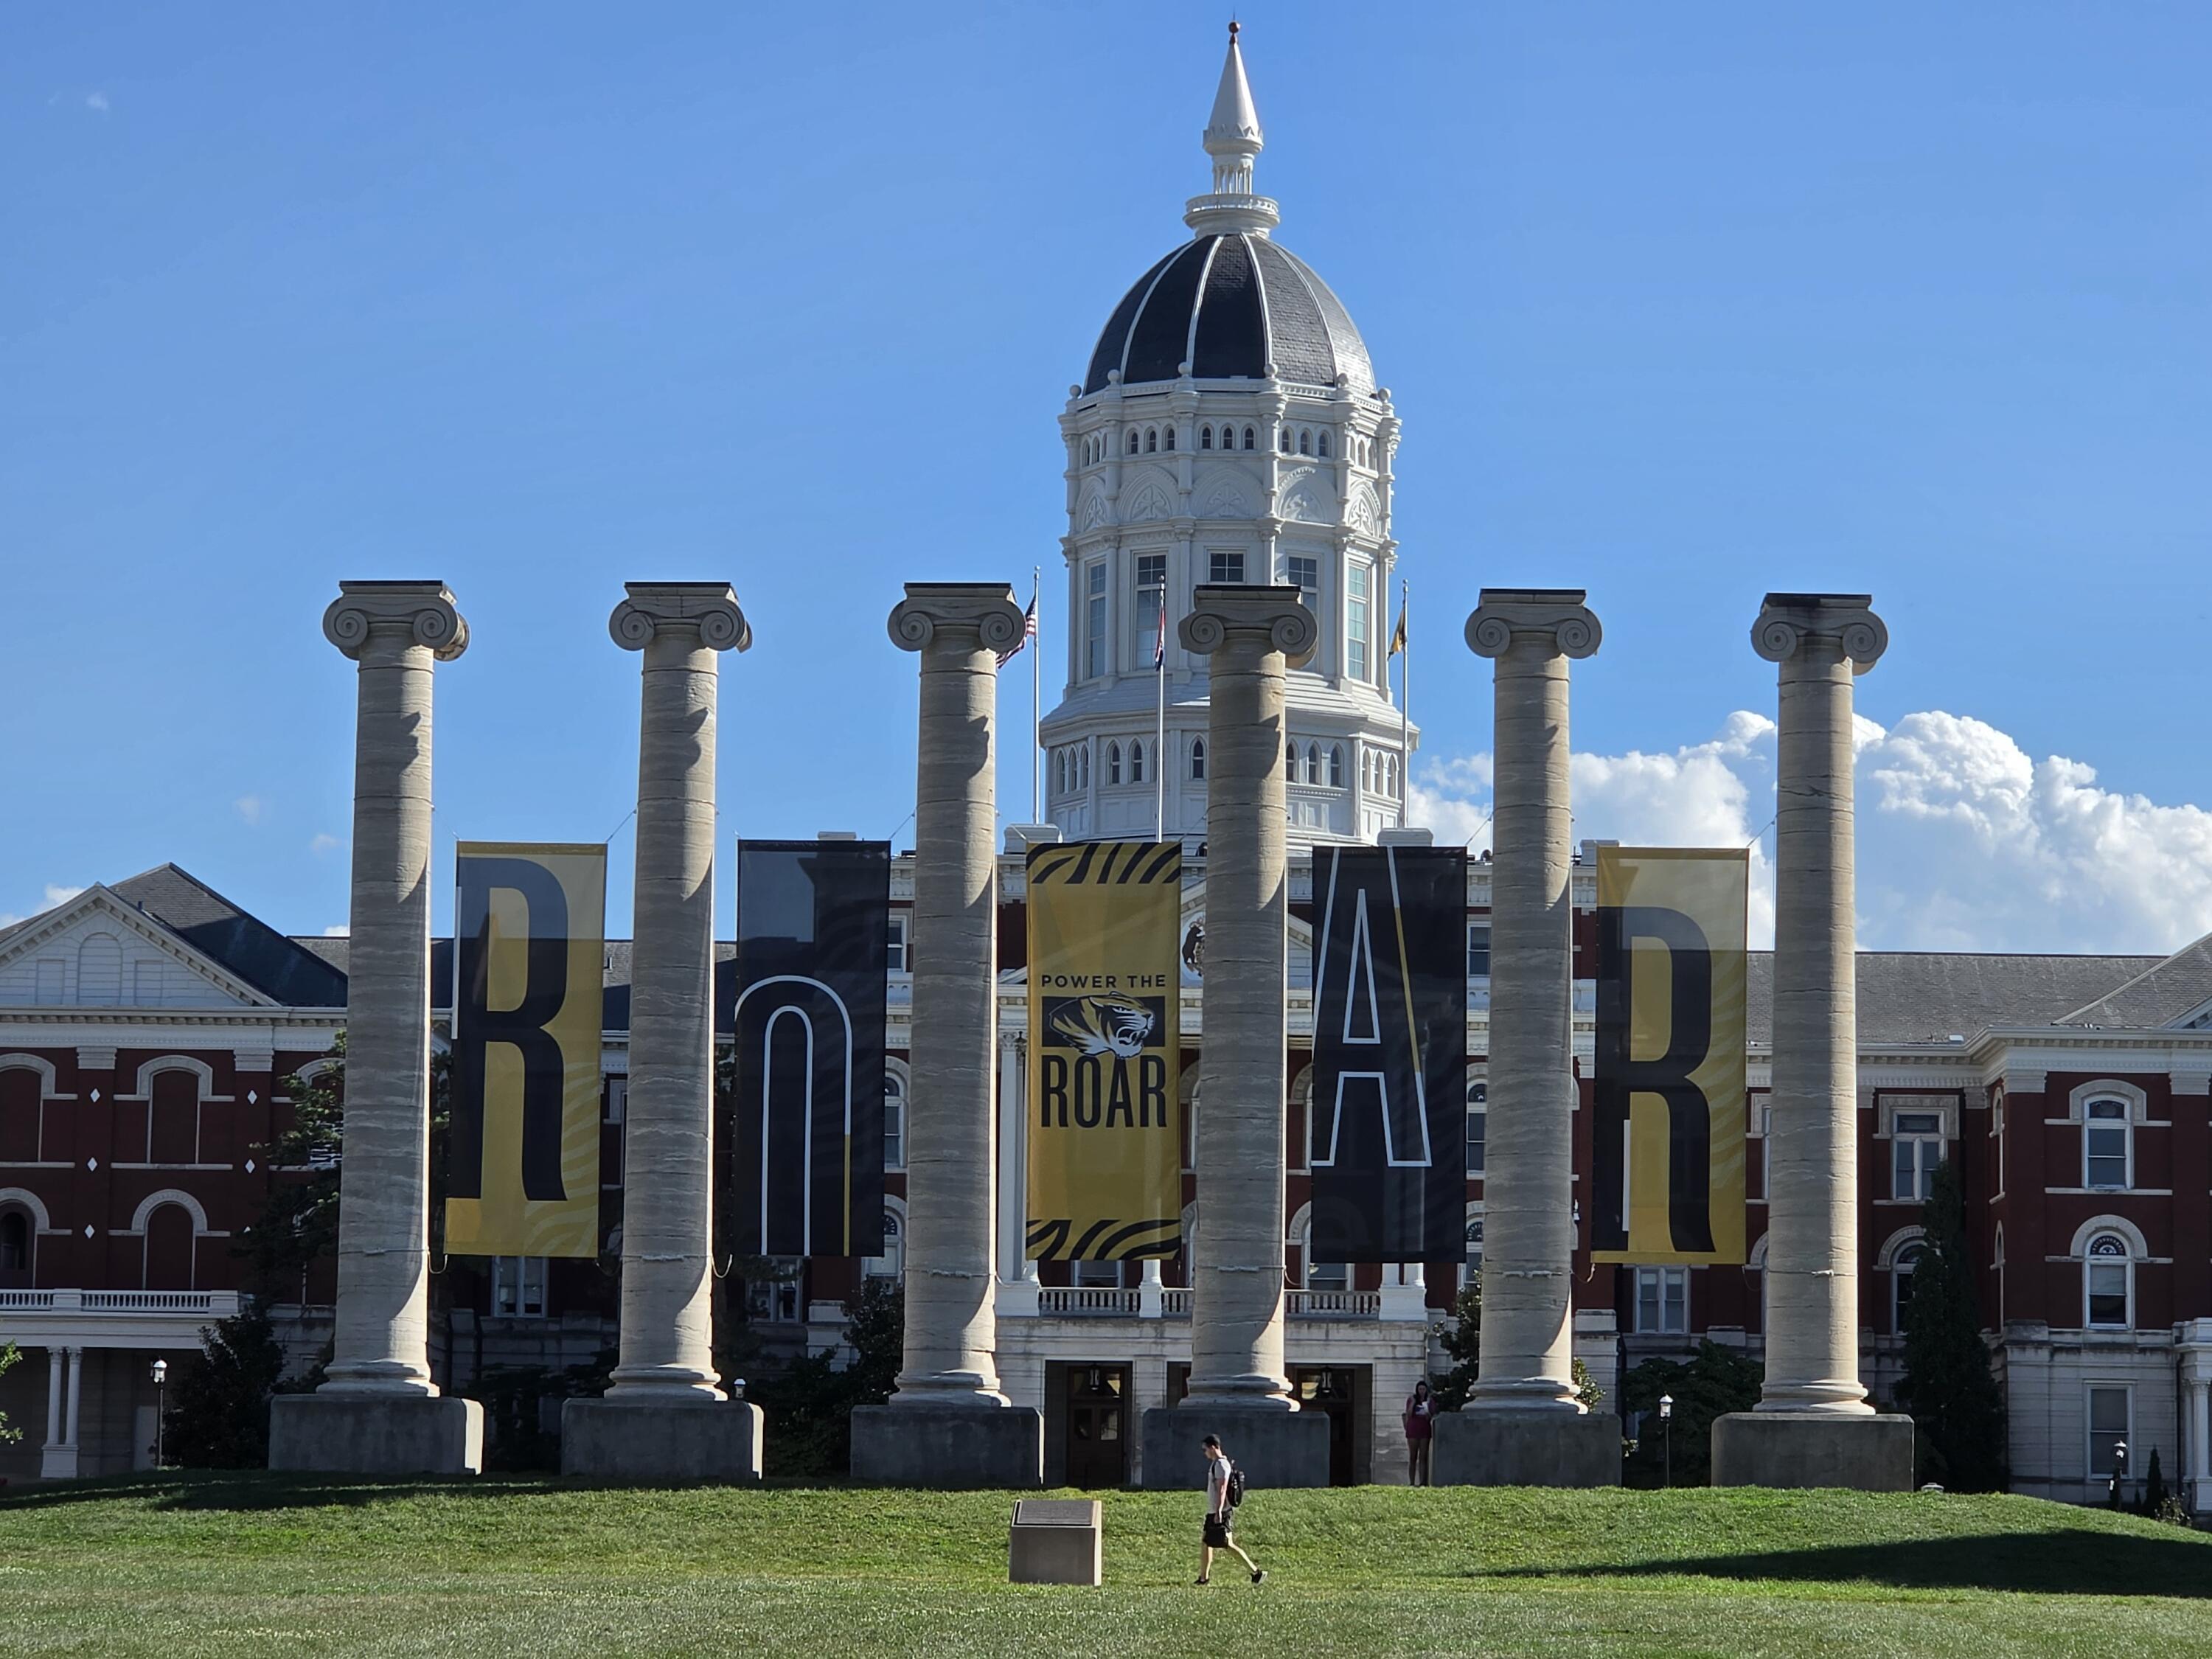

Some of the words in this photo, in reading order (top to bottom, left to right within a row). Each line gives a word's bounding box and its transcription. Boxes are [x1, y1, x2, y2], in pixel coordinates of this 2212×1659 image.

[1041, 975, 1117, 989] POWER
[1127, 974, 1166, 988] THE
[1041, 1054, 1168, 1129] ROAR
